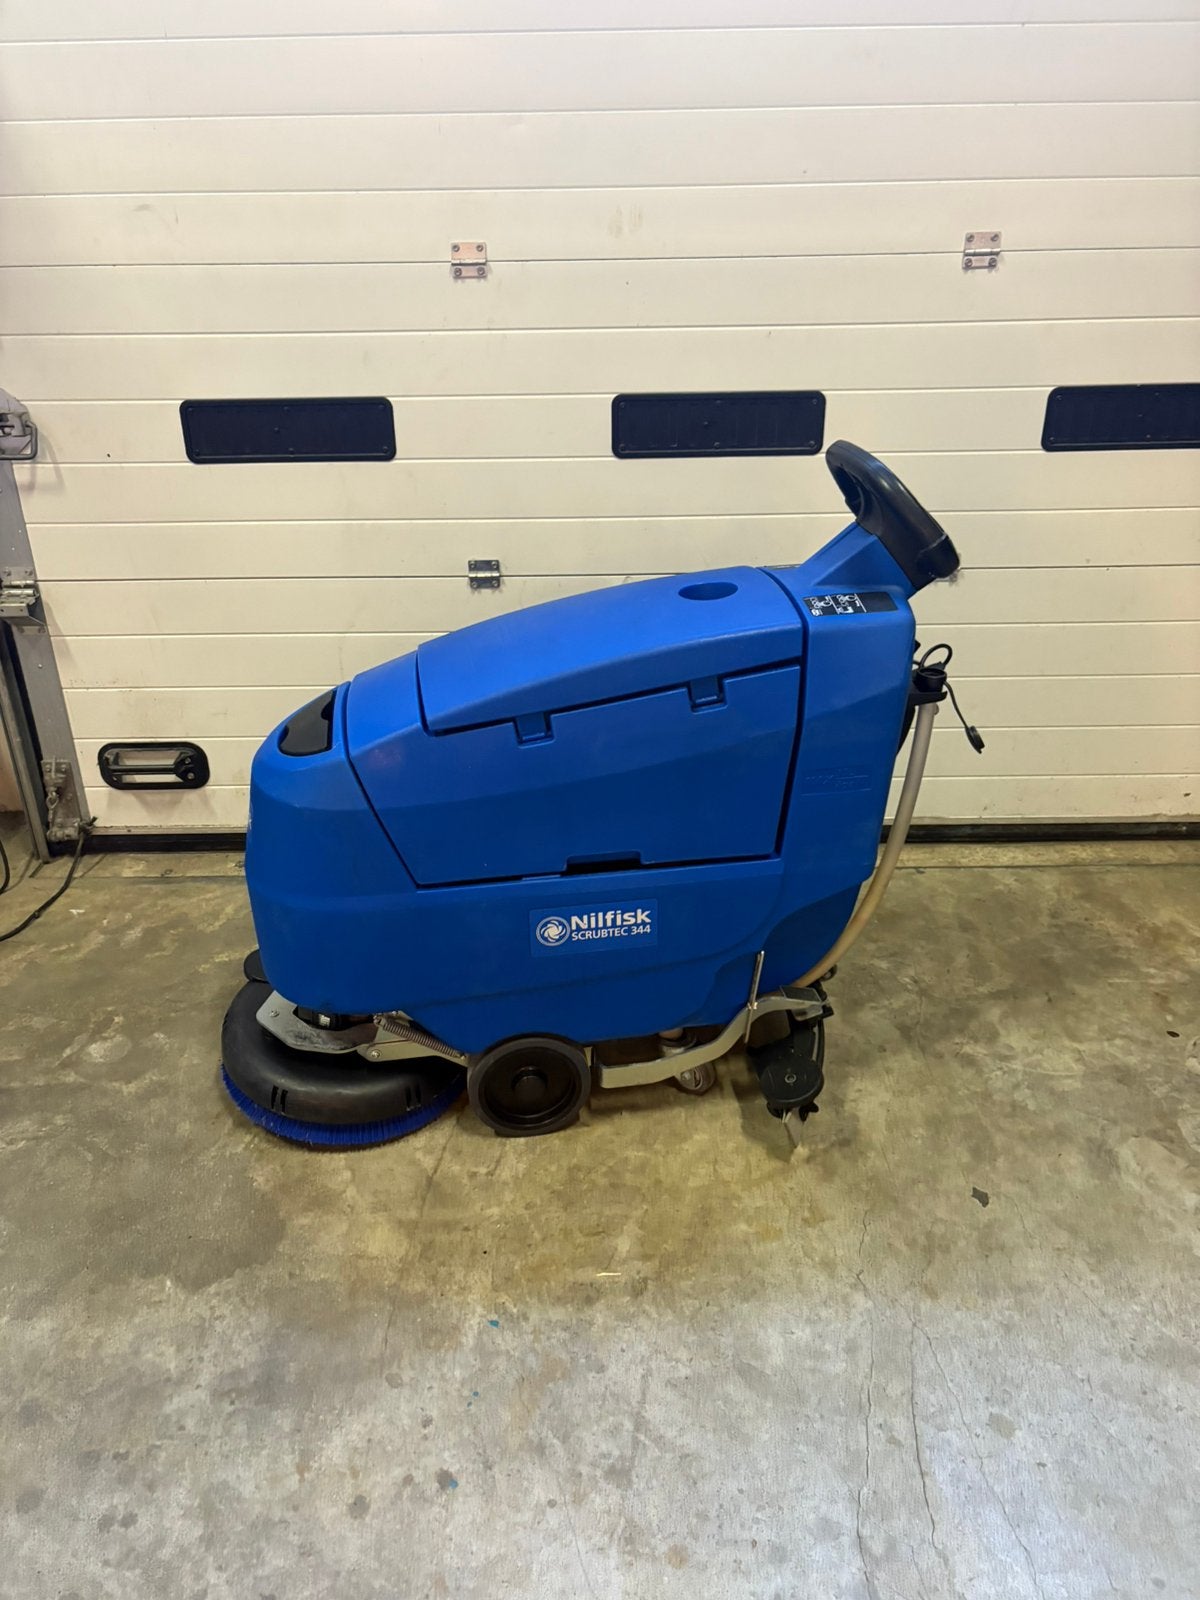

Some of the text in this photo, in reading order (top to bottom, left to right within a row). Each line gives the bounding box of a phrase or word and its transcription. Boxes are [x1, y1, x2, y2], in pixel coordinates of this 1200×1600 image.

[570, 908, 651, 930] Nilfisk
[571, 924, 651, 941] SCRUBTEC 344
